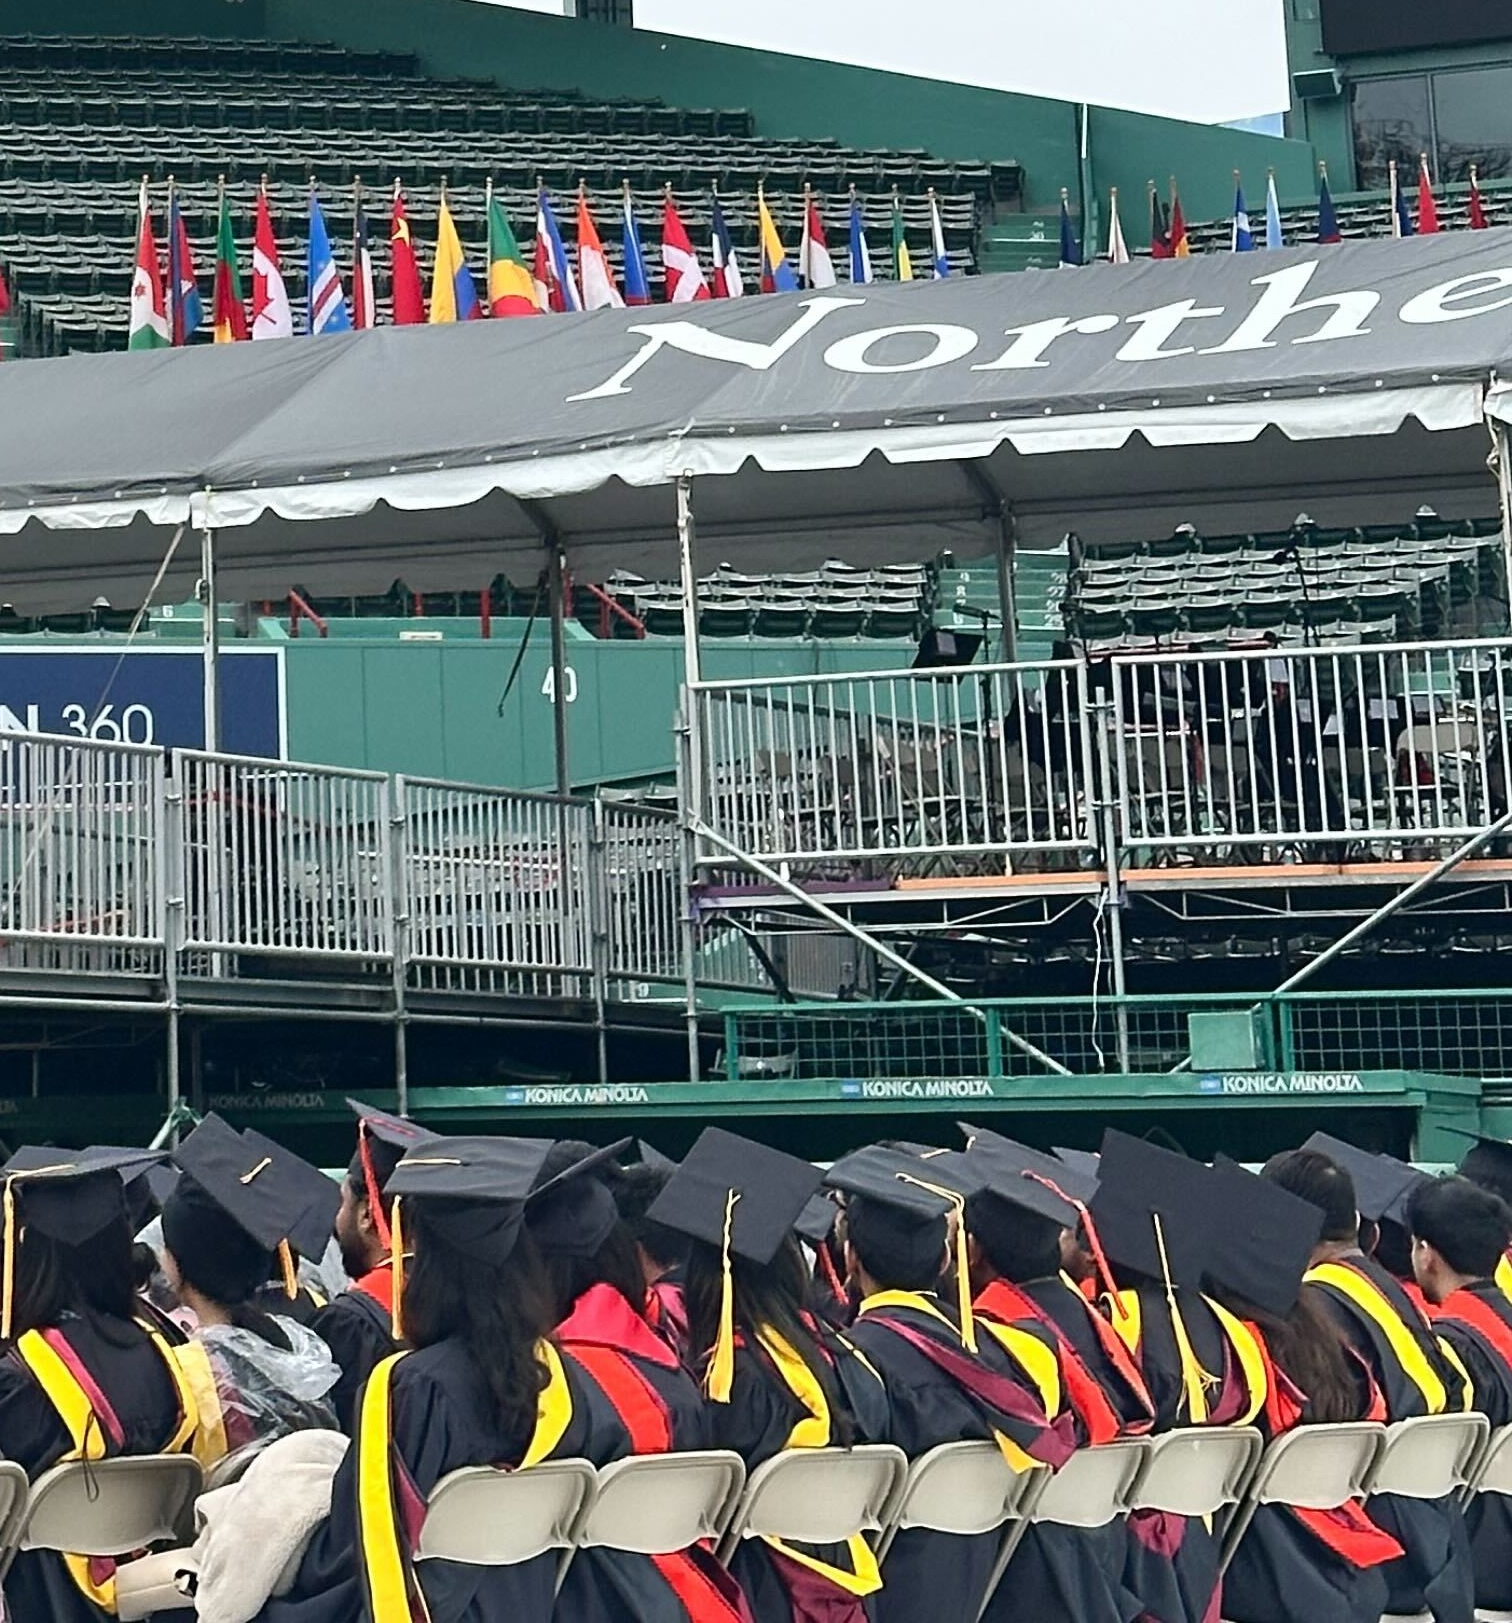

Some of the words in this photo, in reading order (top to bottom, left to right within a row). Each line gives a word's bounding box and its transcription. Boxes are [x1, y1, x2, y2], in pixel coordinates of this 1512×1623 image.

[541, 666, 577, 704] 40
[61, 704, 154, 747] 360
[862, 1079, 924, 1098] KONICA
[924, 1077, 994, 1096] MINOLTA
[1222, 1075, 1287, 1093] KONICA
[1288, 1074, 1364, 1092] MINOLTA
[262, 1091, 326, 1109] MINOLTA
[524, 1087, 583, 1104] KONICA
[583, 1086, 649, 1103] MINOLTA
